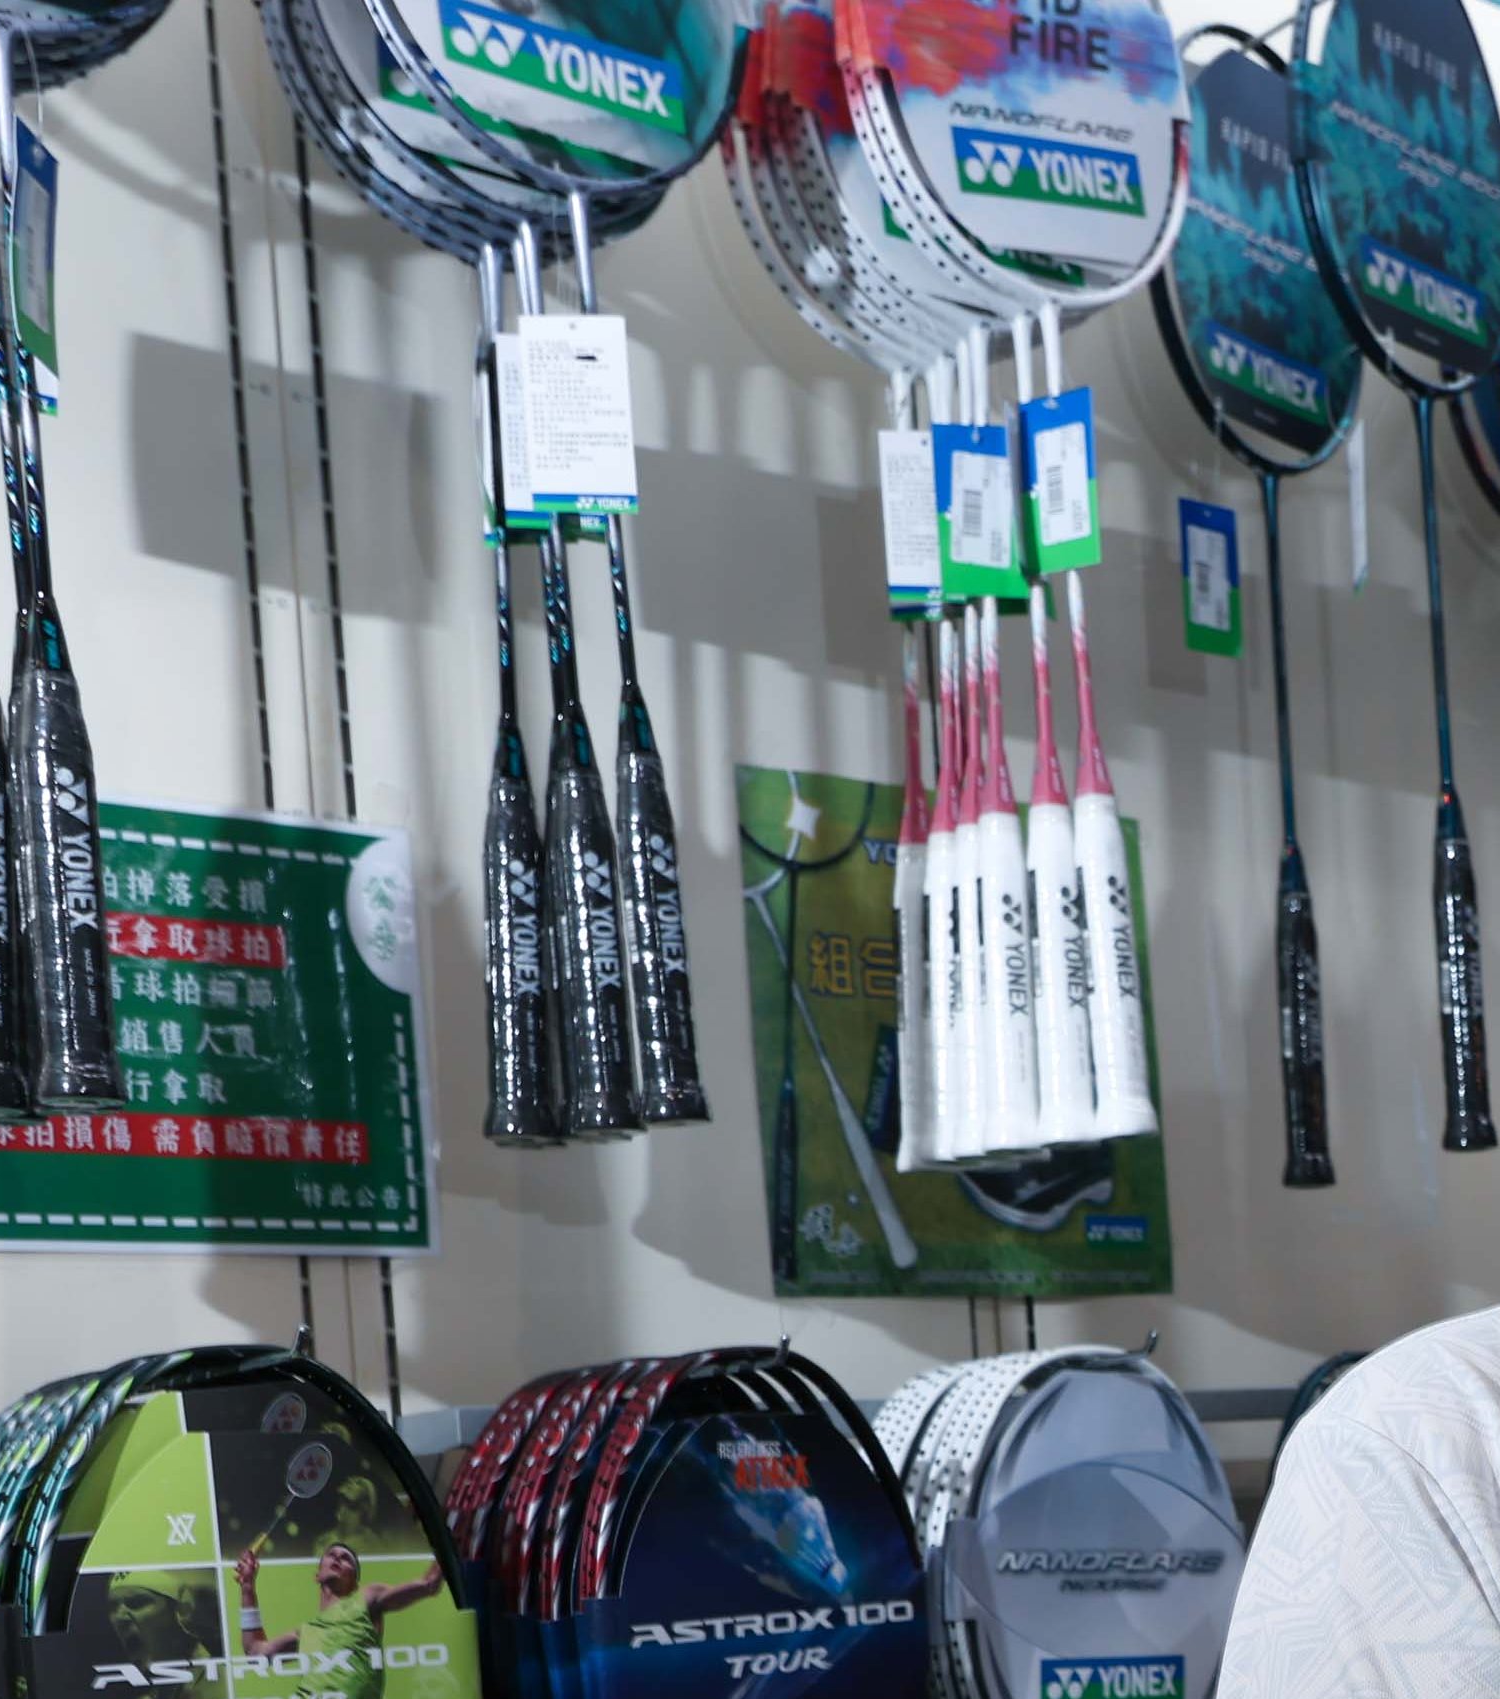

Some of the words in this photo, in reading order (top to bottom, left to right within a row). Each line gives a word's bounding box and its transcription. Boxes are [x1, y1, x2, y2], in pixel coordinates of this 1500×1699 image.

[533, 33, 670, 119] YONEX
[1009, 15, 1110, 72] FIRE
[949, 100, 1135, 143] NANOFLARE
[1029, 148, 1134, 205] YONEX
[1409, 266, 1481, 336] YONEX
[1252, 346, 1324, 415] YONEX
[61, 832, 99, 935] YONEX
[510, 910, 543, 1000] YONEX
[589, 901, 622, 992] YONEX
[654, 886, 688, 976] YONEX
[1111, 923, 1138, 999] YONEX
[1004, 941, 1029, 1017] YONEX
[1063, 934, 1088, 1009] YONEX
[996, 1549, 1226, 1575] NANOFLARE
[629, 1609, 833, 1649] ASTROX
[843, 1600, 915, 1630] 100
[90, 1648, 355, 1690] ASTROX
[363, 1642, 450, 1672] 100
[725, 1645, 834, 1679] TOUR
[1098, 1663, 1178, 1699] YONEX
